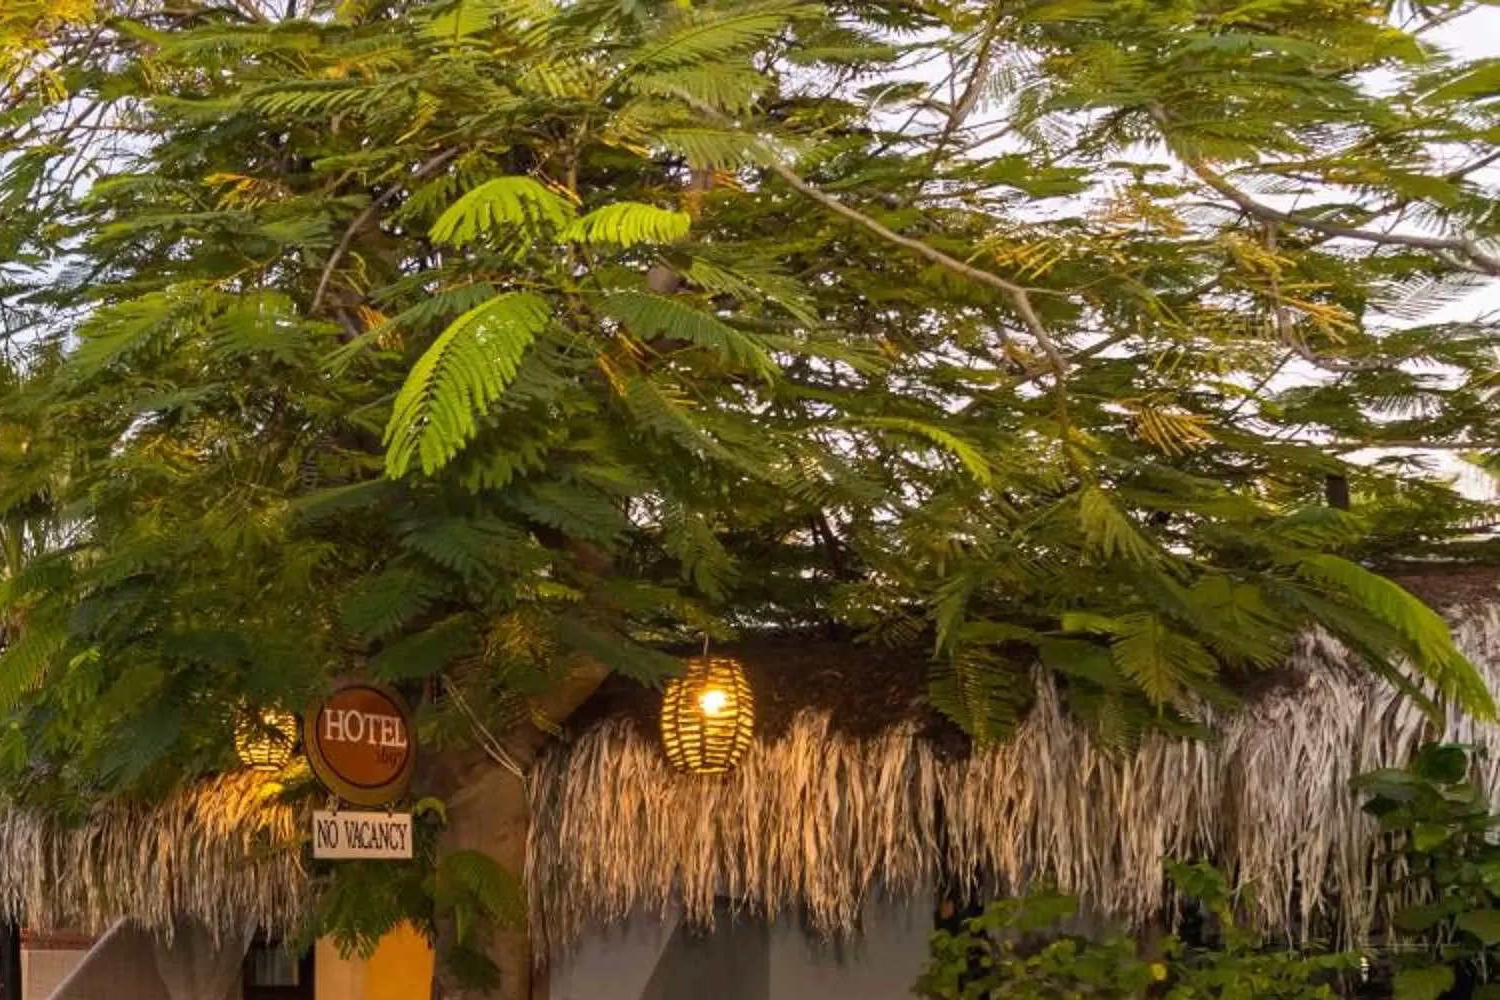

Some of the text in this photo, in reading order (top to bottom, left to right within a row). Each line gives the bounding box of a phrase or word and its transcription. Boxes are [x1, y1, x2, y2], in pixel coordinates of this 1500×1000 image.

[324, 709, 407, 749] HOTEL
[317, 819, 408, 850] NO VACANCY
